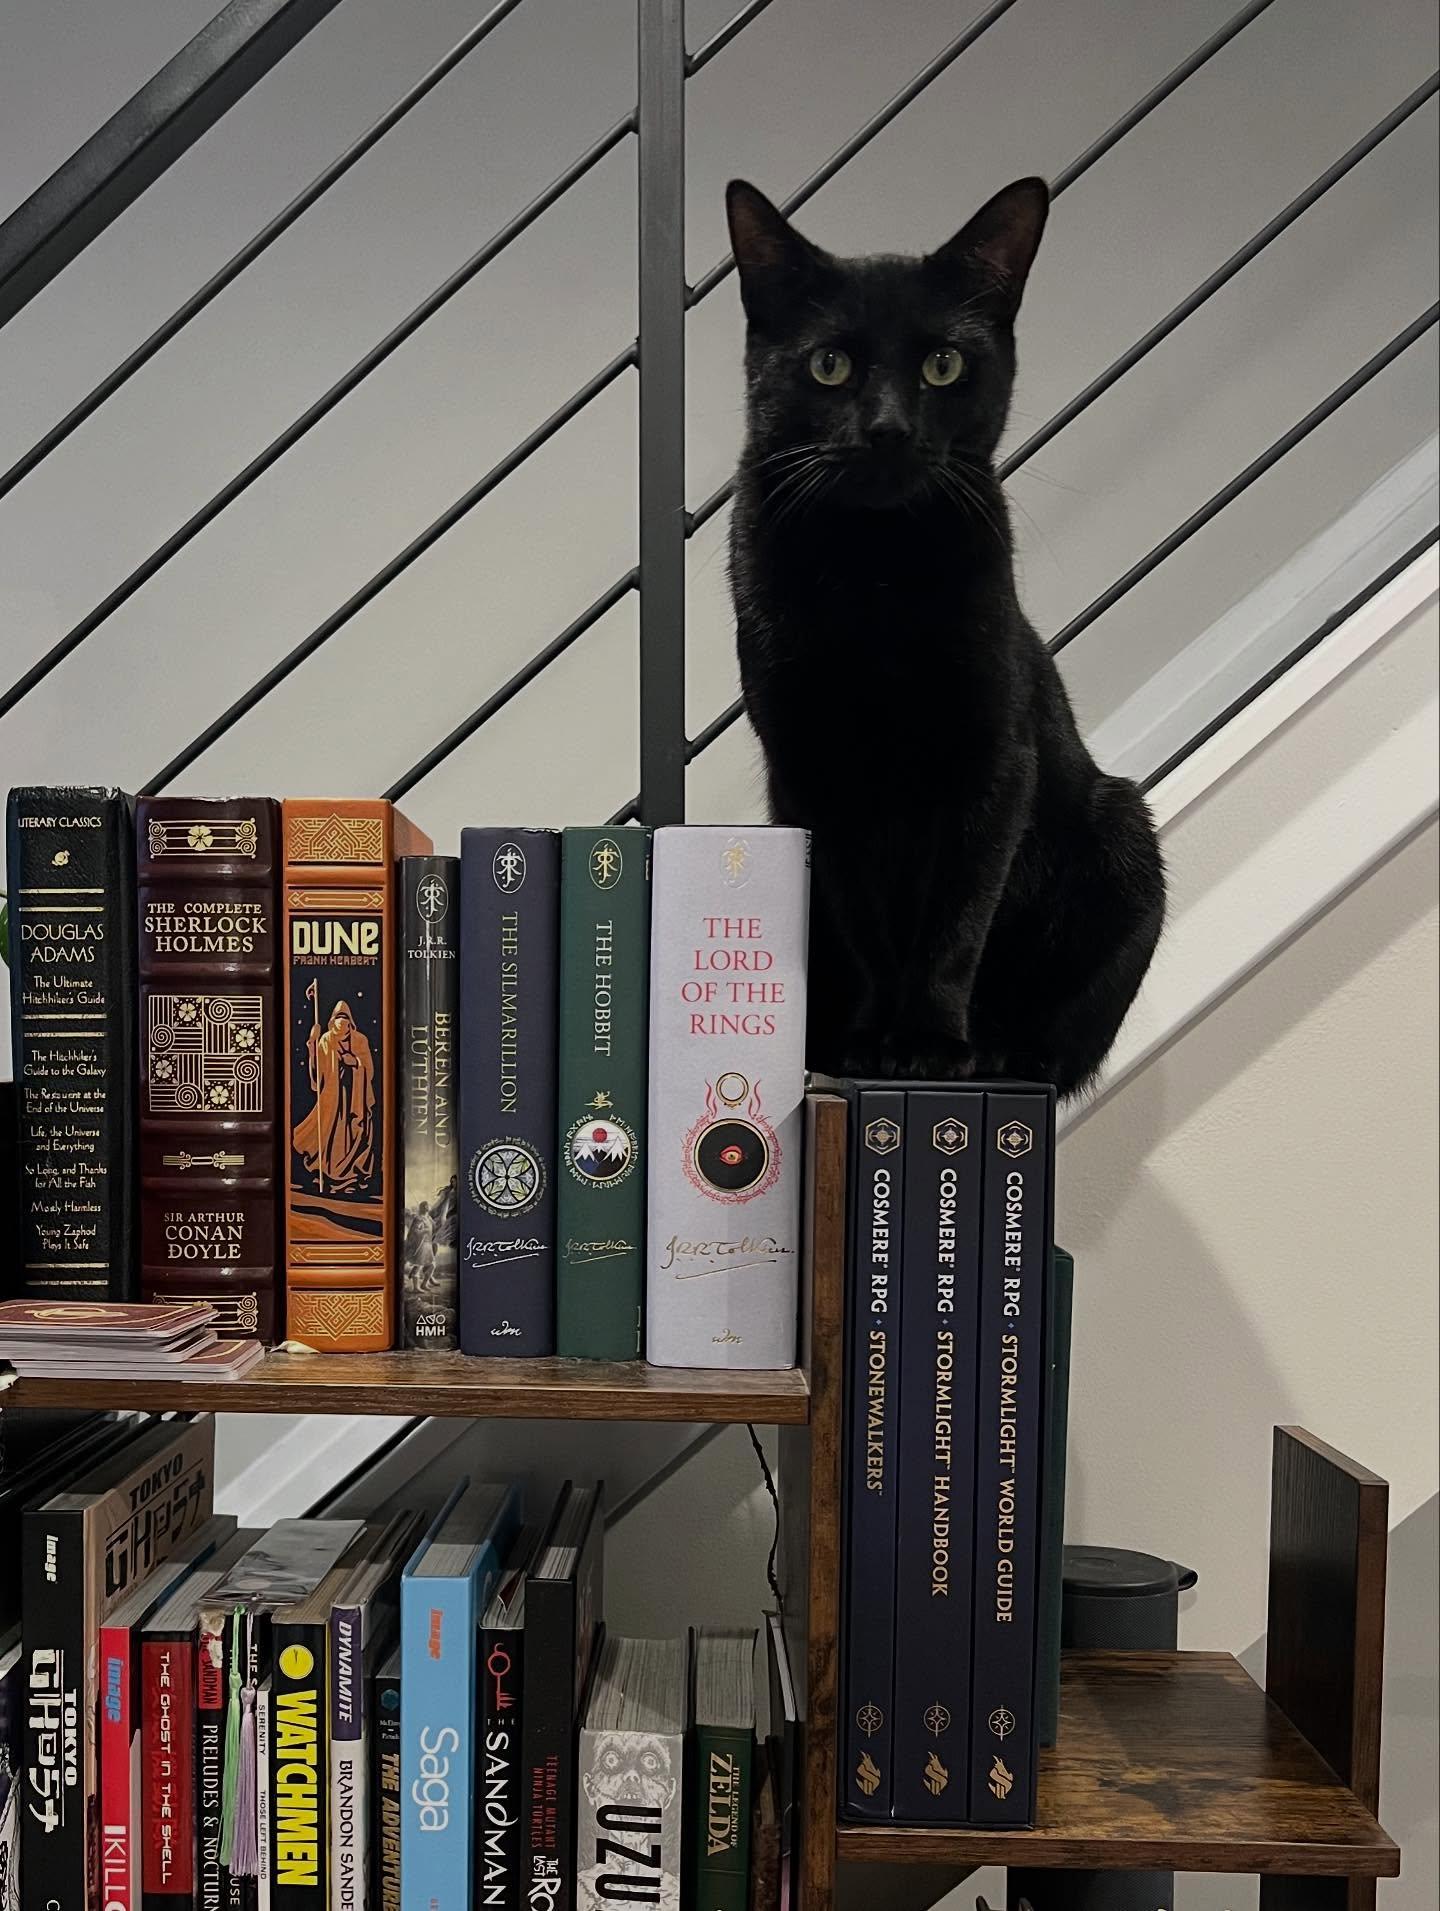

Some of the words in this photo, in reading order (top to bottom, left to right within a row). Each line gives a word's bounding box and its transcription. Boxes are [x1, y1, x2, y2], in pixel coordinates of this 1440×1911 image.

[18, 817, 57, 828] LITERARY
[58, 817, 102, 828] CLASSICS
[148, 903, 175, 914] THE
[184, 903, 262, 914] COMPLETE
[21, 924, 104, 940] DOUGLAS
[144, 917, 267, 934] SHERLOCK
[292, 921, 379, 955] DUNE
[418, 936, 447, 946] J.R.R.
[502, 911, 518, 956] THE
[703, 918, 762, 939] THE
[30, 946, 95, 963] ADAMS
[156, 936, 254, 952] HOLMES
[408, 950, 456, 960] TOLKIEN
[596, 920, 612, 967] THE
[294, 956, 328, 966] FRANK
[330, 956, 378, 966] HERBERT
[694, 950, 773, 971] LORD
[22, 991, 74, 1004] Hitchhiker's
[77, 991, 105, 1004] Guide
[33, 975, 50, 988] The
[53, 975, 93, 988] Ultimate
[682, 982, 718, 1003] OF
[726, 982, 785, 1003] THE
[594, 974, 612, 1057] HOBBIT
[690, 1014, 776, 1035] RINGS
[434, 1011, 452, 1090] BEREN
[500, 962, 518, 1113] SILMARILLION
[24, 1064, 48, 1076] Guide
[51, 1066, 60, 1076] to
[62, 1064, 74, 1076] the
[76, 1064, 106, 1078] Galaxy
[32, 1050, 47, 1062] The
[24, 1088, 39, 1098] The
[84, 1089, 92, 1098] at
[94, 1088, 106, 1098] the
[410, 1024, 431, 1135] LÚTHIEN
[26, 1102, 42, 1113] End
[44, 1102, 53, 1113] of
[55, 1102, 67, 1113] the
[70, 1102, 104, 1113] Universe
[434, 1097, 448, 1149] AND
[36, 1142, 50, 1152] and
[53, 1141, 94, 1152] Everything
[50, 1126, 62, 1137] the
[65, 1126, 100, 1137] Universe
[35, 1177, 46, 1188] for
[48, 1176, 62, 1188] All
[64, 1177, 76, 1188] the
[80, 1176, 96, 1188] Fish
[62, 1165, 76, 1174] and
[78, 1163, 107, 1174] Thanks
[31, 1201, 61, 1215] Mostly
[64, 1201, 101, 1212] Harmless
[164, 1213, 183, 1222] SIR
[188, 1213, 245, 1222] ARTHUR
[36, 1224, 60, 1238] Young
[64, 1224, 96, 1238] Zaphod
[74, 1238, 89, 1250] Safe
[166, 1225, 243, 1240] CONAN
[168, 1244, 242, 1260] DOYLE
[871, 1274, 888, 1314] RPG
[937, 1274, 954, 1314] RPG
[1004, 1278, 1020, 1317] RPG
[416, 1326, 446, 1336] HMH
[866, 1330, 886, 1491] STONEWALKERS
[935, 1331, 953, 1461] STORMLIGHT
[1000, 1334, 1018, 1466] STORMLIGHT
[130, 1453, 184, 1512] TOKYO
[998, 1479, 1015, 1554] WORLD
[932, 1476, 950, 1597] HANDBOOK
[996, 1558, 1012, 1622] GUIDE
[160, 1652, 170, 1688] THE
[338, 1620, 354, 1724] DYNAMITE
[64, 1688, 77, 1786] TOKYO
[160, 1694, 171, 1754] GHOST
[258, 1704, 266, 1756] SERENITY
[487, 1718, 516, 1726] THE
[202, 1724, 220, 1808] PRELUDES
[381, 1753, 400, 1792] THE
[412, 1726, 460, 1832] Saga
[545, 1755, 558, 1802] TEENAGE
[276, 1690, 318, 1886] WATCHMEN
[532, 1767, 544, 1800] NINJA
[162, 1784, 172, 1819] THE
[336, 1760, 353, 1848] BRANDON
[707, 1752, 732, 1857] ZELDA
[731, 1792, 739, 1832] LEGEND
[204, 1816, 218, 1832] &
[532, 1804, 543, 1848] TURTLES
[544, 1807, 556, 1849] MUTANT
[162, 1826, 173, 1884] SHELL
[730, 1834, 738, 1848] OF
[534, 1855, 546, 1877] LAST
[546, 1858, 559, 1876] THE
[230, 1874, 240, 1905] USE
